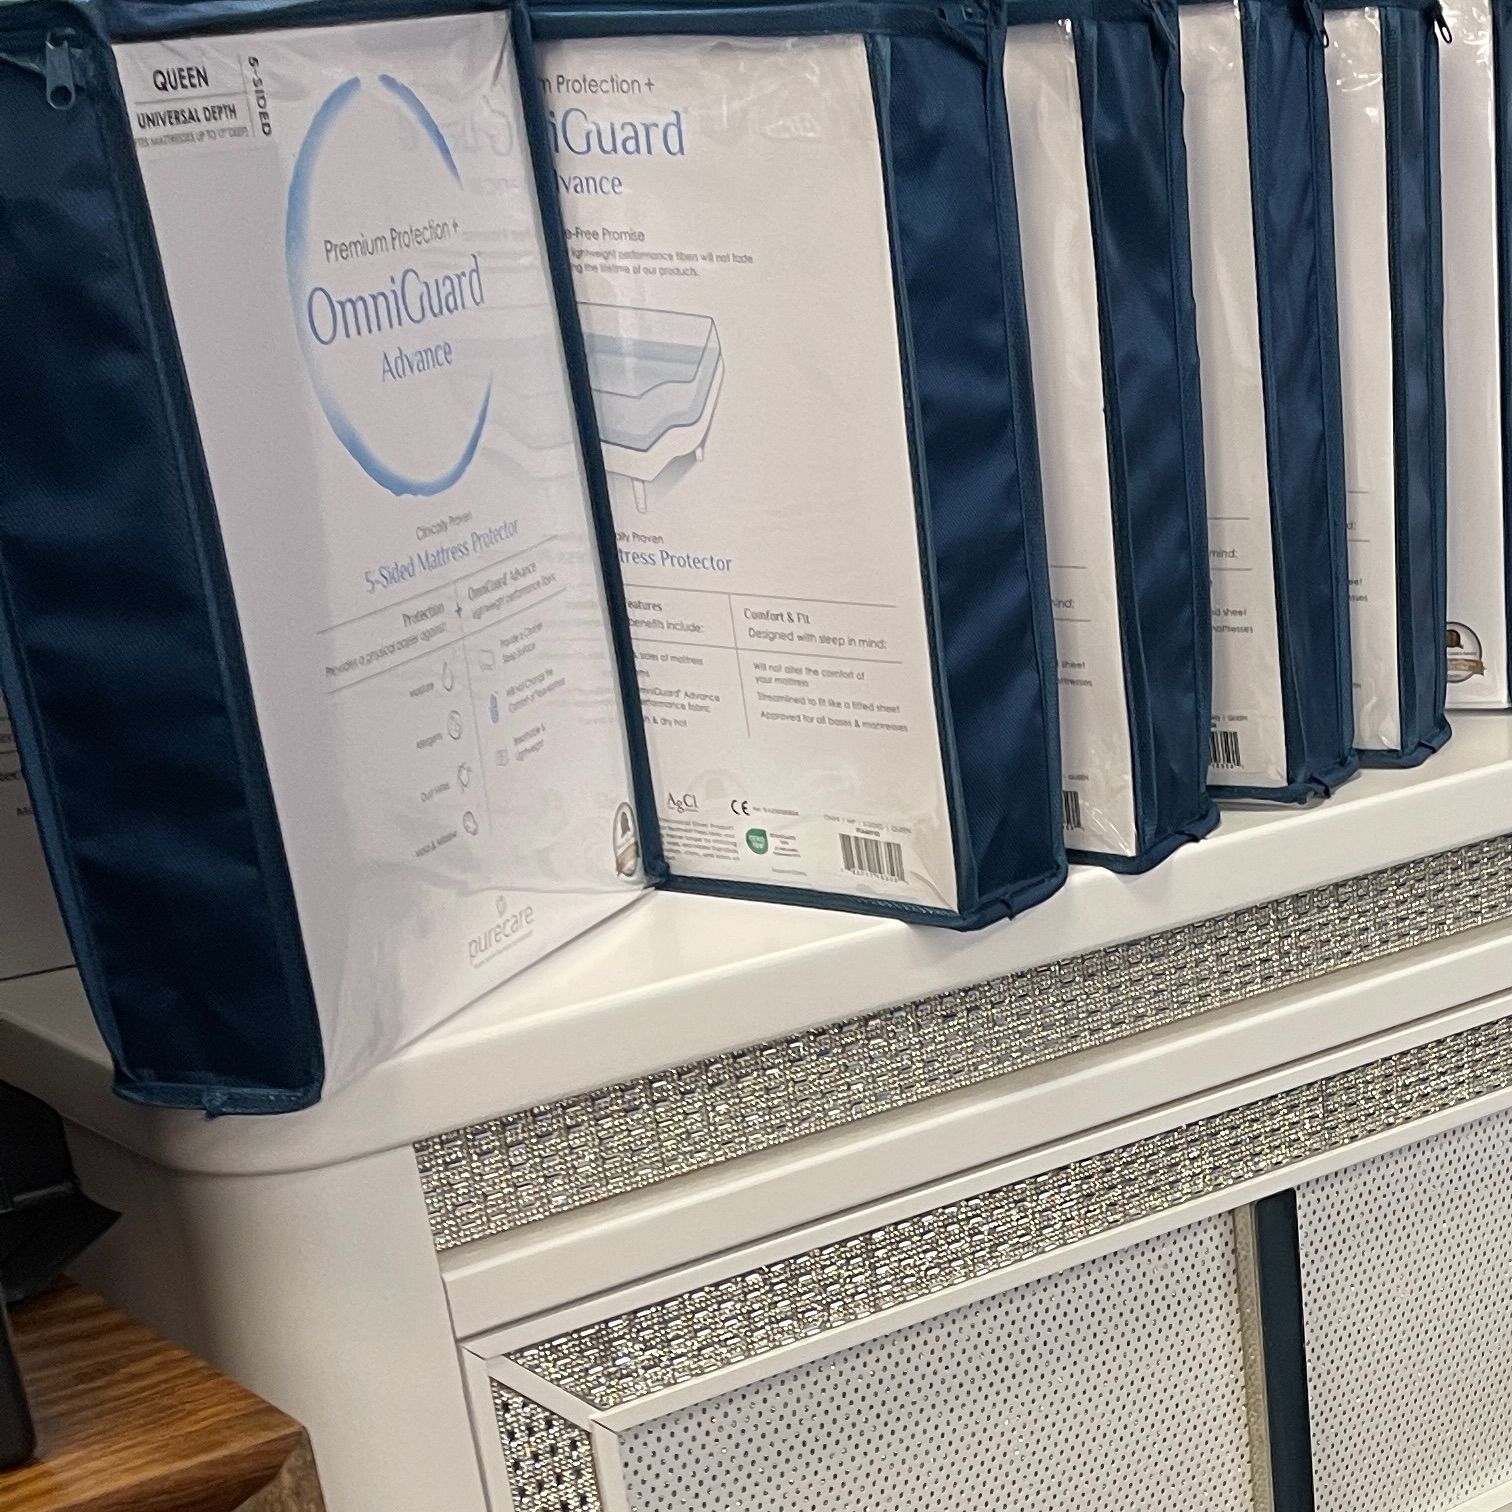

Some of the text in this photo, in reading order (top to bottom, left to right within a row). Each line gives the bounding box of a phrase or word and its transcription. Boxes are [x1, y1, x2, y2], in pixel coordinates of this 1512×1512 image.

[153, 66, 209, 92] QUEEN
[556, 74, 642, 95] Protection
[248, 56, 272, 136] 5-SIDED
[137, 103, 237, 129] UNIVERSAL DEPTH
[549, 108, 685, 156] iGuard
[553, 169, 623, 196] vance
[323, 230, 388, 263] Premium
[390, 219, 449, 251] Protection
[602, 227, 645, 243] Promise
[307, 253, 485, 346] OmniGuard
[382, 342, 453, 382] Advance
[632, 532, 664, 544] Proven
[364, 519, 519, 595] 5-Sided Mattress Protector
[618, 548, 733, 572] tress Protector
[627, 600, 811, 625] eatures Comfort & Fit
[748, 627, 887, 650] Designed with sleep in mind:
[821, 668, 855, 679] comfort
[468, 906, 536, 964] purecare
